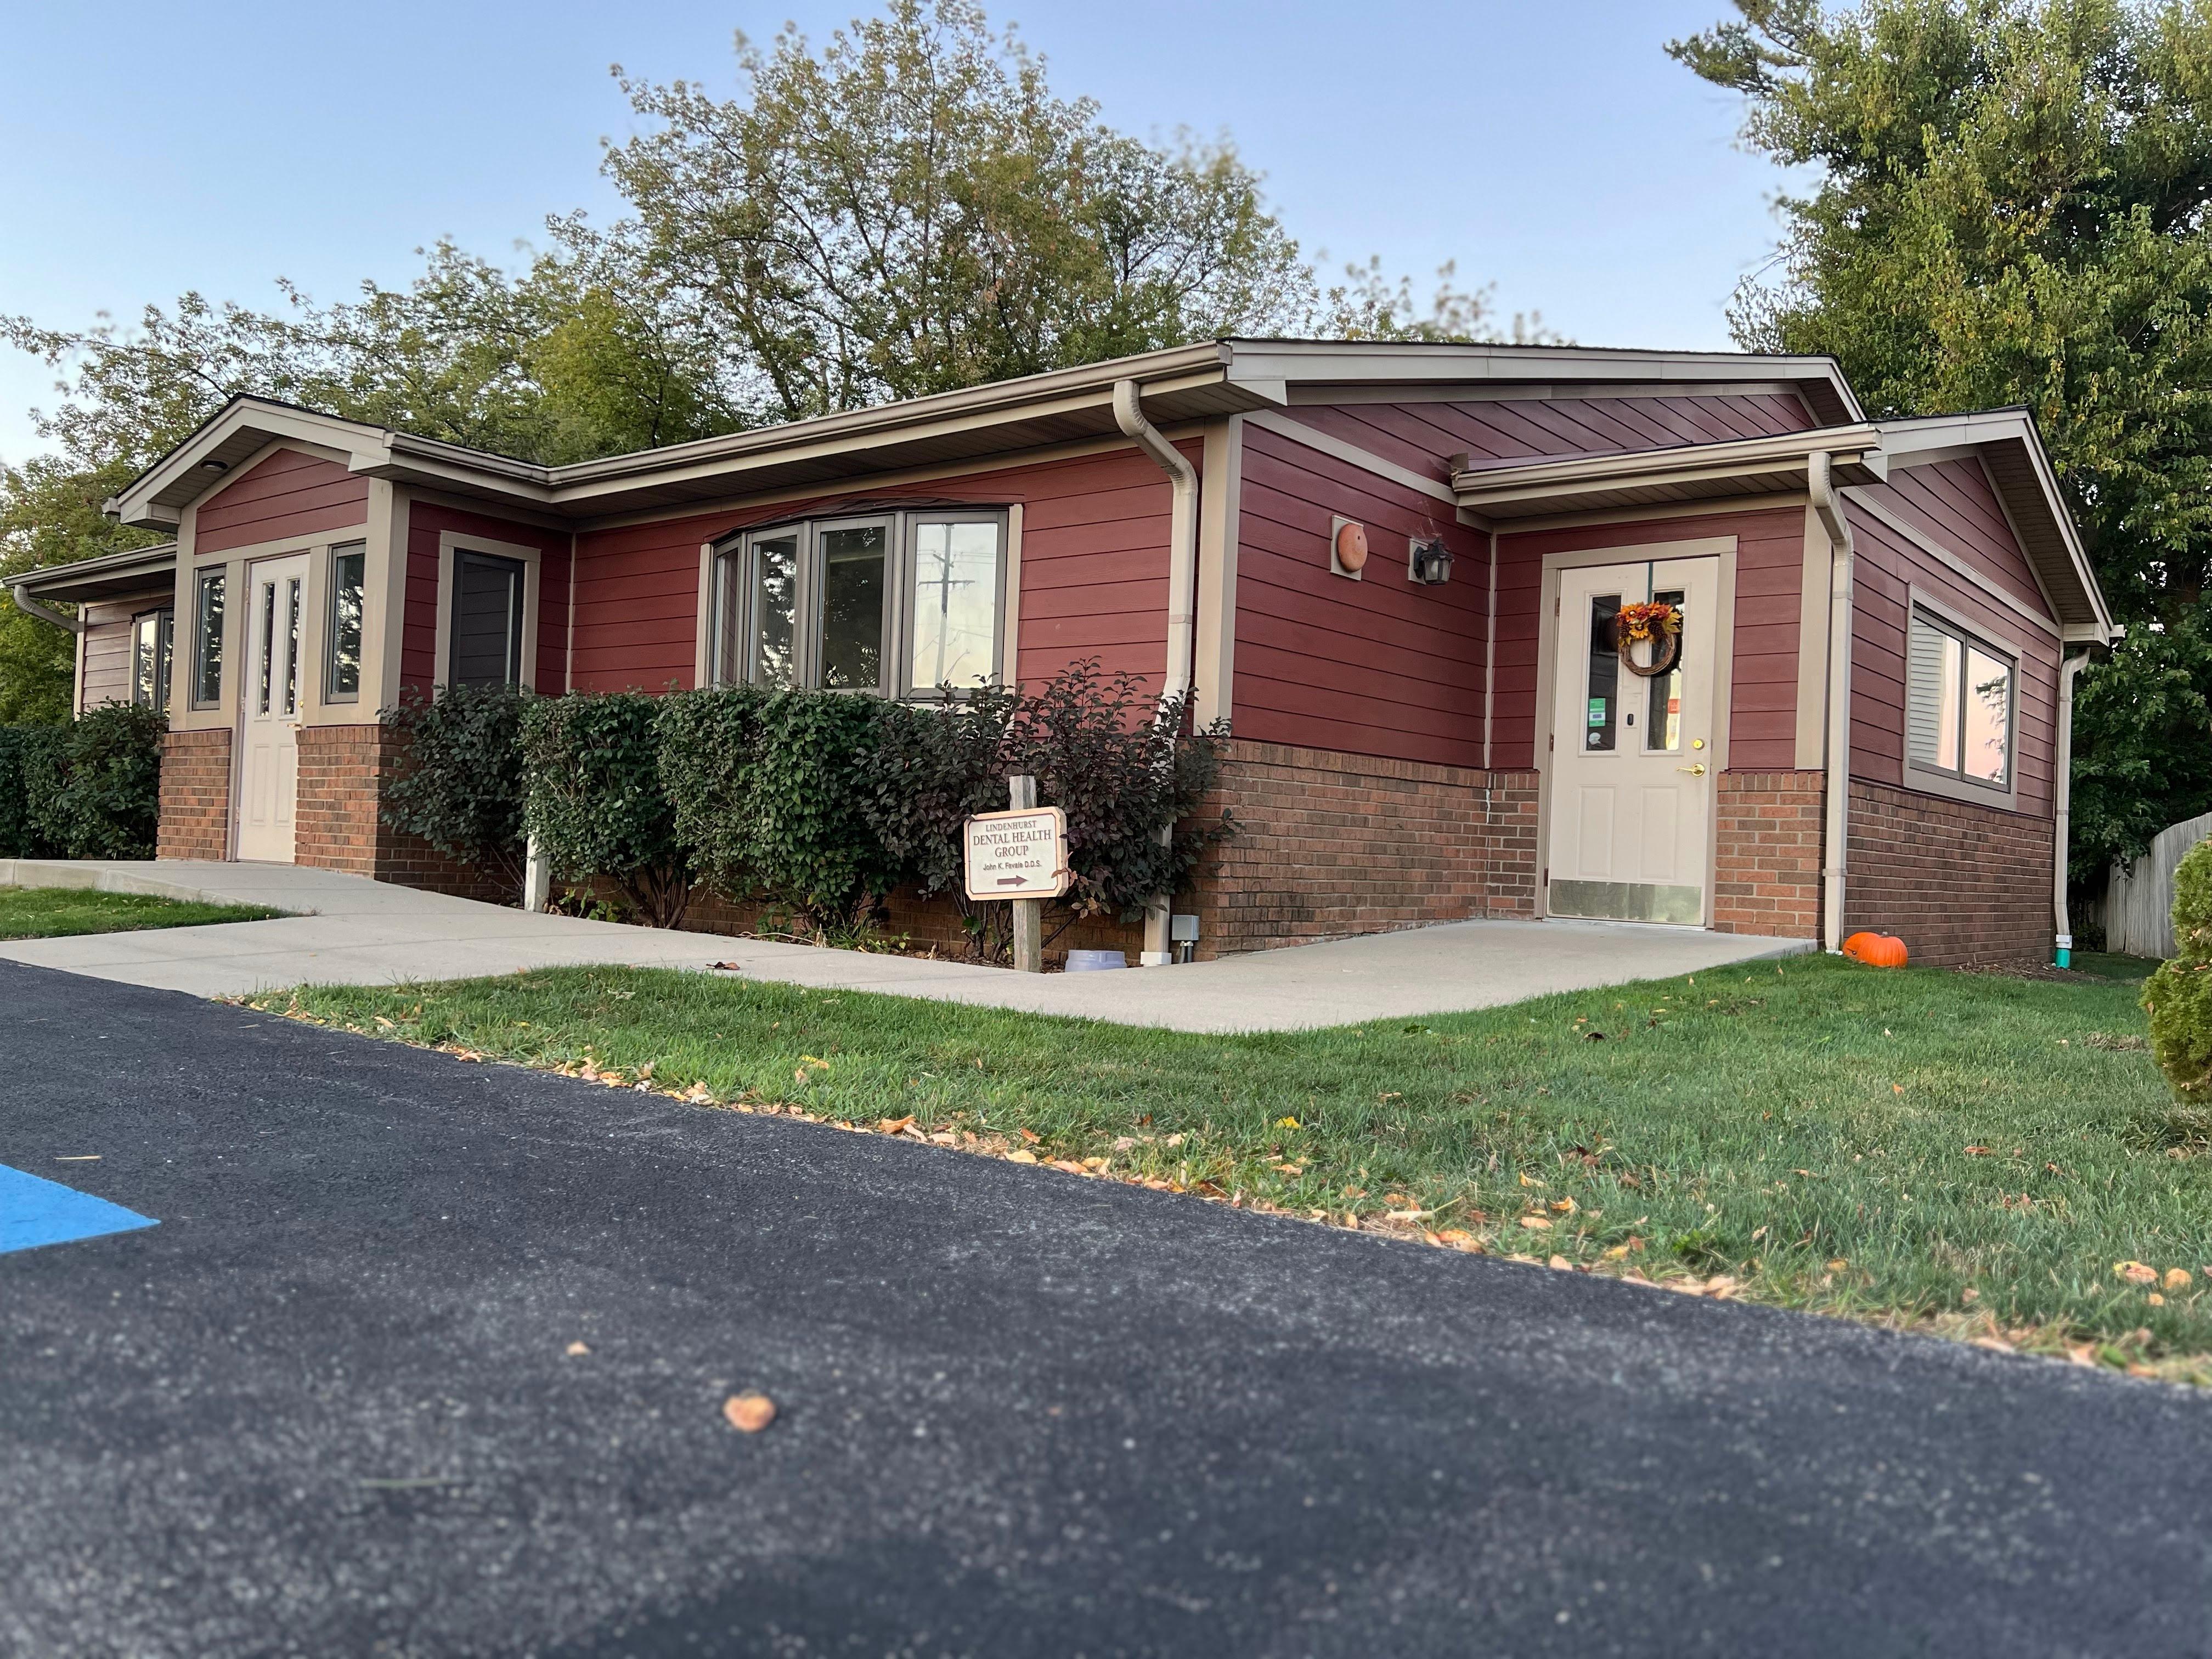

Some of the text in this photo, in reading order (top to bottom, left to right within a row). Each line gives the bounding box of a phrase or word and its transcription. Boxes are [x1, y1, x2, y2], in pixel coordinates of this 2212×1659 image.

[986, 820, 1036, 832] LINDENHURST
[973, 830, 1051, 845] DENTAL HEALTH
[995, 845, 1028, 857] GROUP
